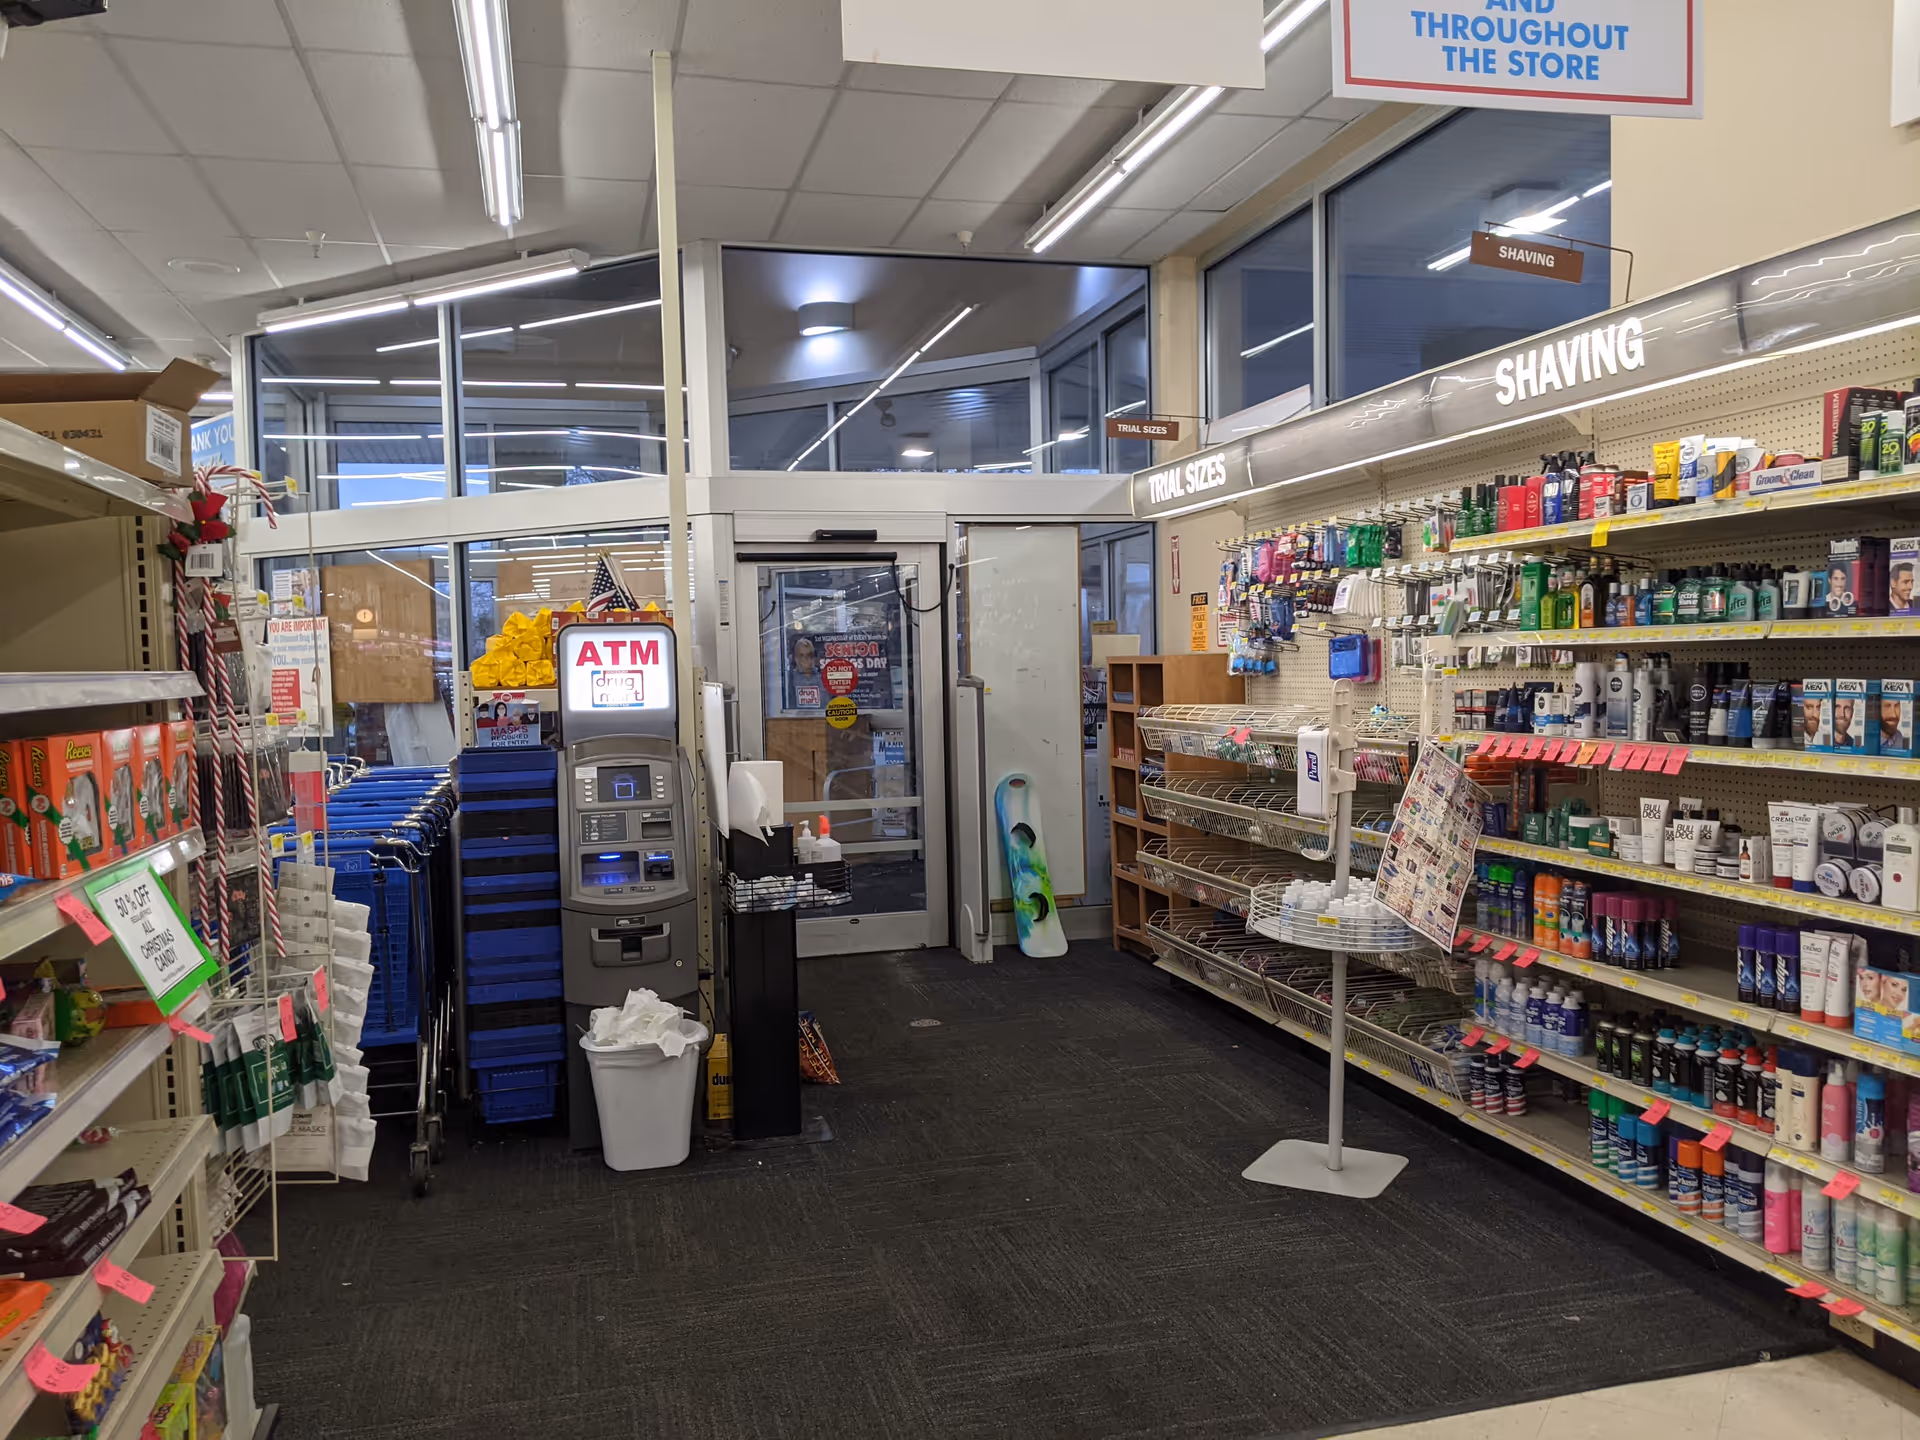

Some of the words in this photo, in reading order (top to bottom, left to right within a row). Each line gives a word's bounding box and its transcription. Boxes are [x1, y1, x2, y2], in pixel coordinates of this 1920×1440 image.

[1411, 10, 1629, 50] THROUGHOUT
[1442, 46, 1497, 74] THE
[1507, 49, 1600, 80] STORE
[1498, 245, 1555, 268] SHAVING
[1495, 316, 1645, 406] SHAVING
[1117, 424, 1141, 433] TRIAL
[1143, 425, 1167, 435] SIZES
[1148, 467, 1185, 504] TRIAL
[1185, 452, 1226, 493] SIZES
[1756, 474, 1782, 486] Groom
[1791, 470, 1815, 480] Clean
[1893, 543, 1914, 551] MEN
[1192, 595, 1206, 604] FREE
[269, 622, 279, 632] YOU
[281, 621, 292, 632] ARE
[576, 640, 659, 666] ATM
[825, 641, 879, 657] SENIOR
[866, 657, 887, 668] DAY
[596, 670, 635, 690] drug
[799, 688, 814, 696] drug
[800, 696, 819, 704] mart
[491, 726, 529, 736] MASKS
[1309, 754, 1317, 778] Purell
[1643, 811, 1661, 819] DOG
[1644, 804, 1661, 812] BULL
[1677, 824, 1694, 832] BULL
[1700, 824, 1712, 832] ULL
[1827, 825, 1847, 837] CREMO
[1675, 832, 1694, 840] DOG
[1700, 832, 1712, 840] OG
[1818, 874, 1840, 888] CREMO
[1858, 874, 1866, 899] CREMO
[114, 896, 129, 917] 50
[125, 892, 137, 911] %
[133, 884, 151, 907] OFF
[141, 919, 155, 935] ALL
[1606, 916, 1617, 951] edge
[140, 928, 175, 959] CHRISTMAS
[1802, 945, 1822, 953] CREMO
[154, 947, 178, 972] CANDY
[1776, 954, 1789, 995] edge
